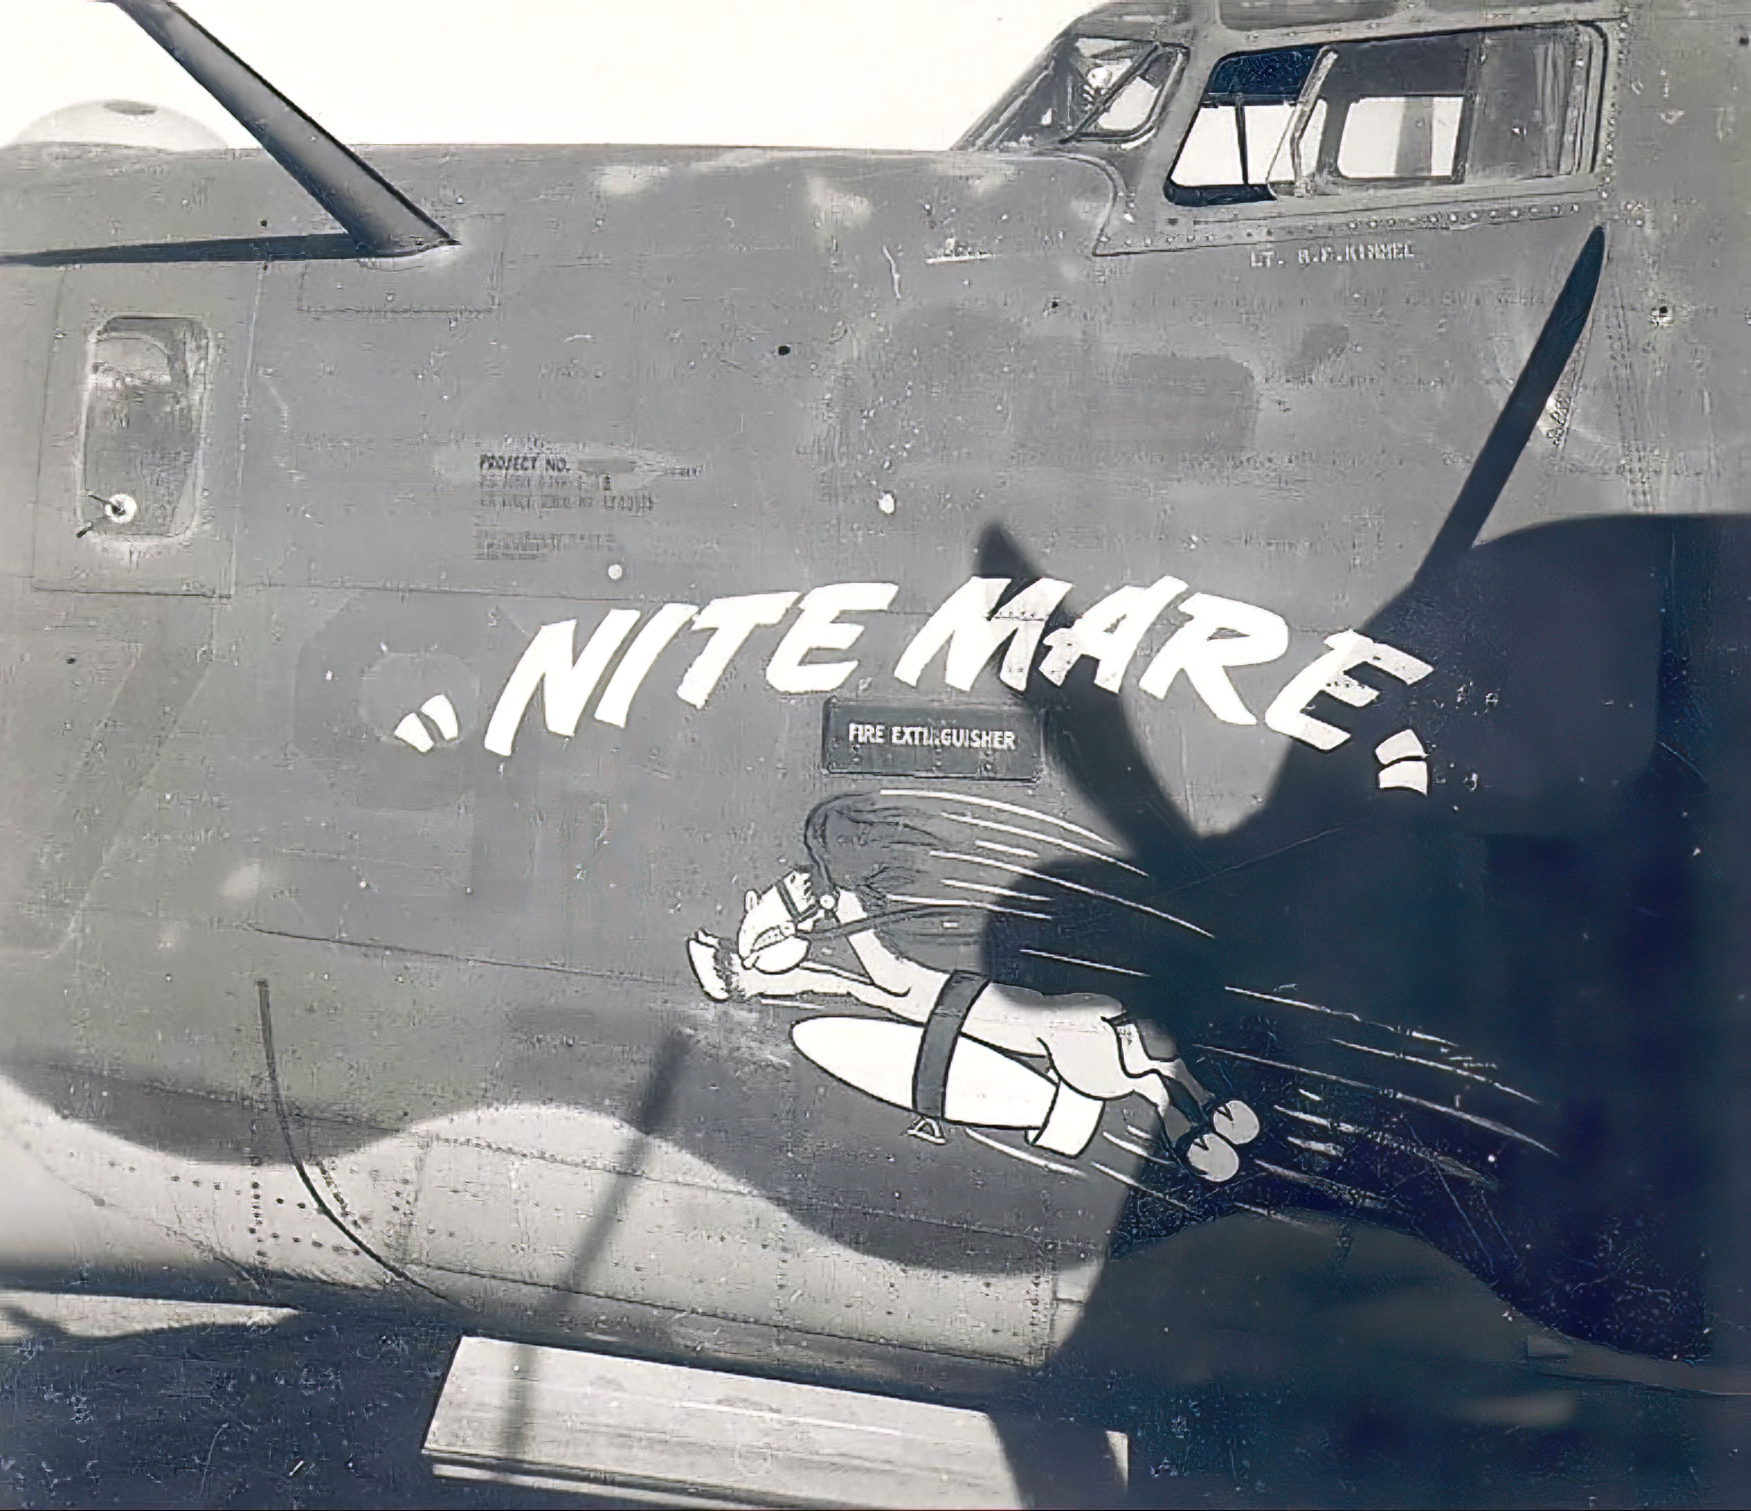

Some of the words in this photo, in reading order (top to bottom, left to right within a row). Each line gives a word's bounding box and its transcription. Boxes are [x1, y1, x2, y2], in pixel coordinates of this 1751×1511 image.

[1250, 249, 1285, 268] LT.
[480, 454, 539, 472] PROJECT
[848, 722, 885, 745] FIRE
